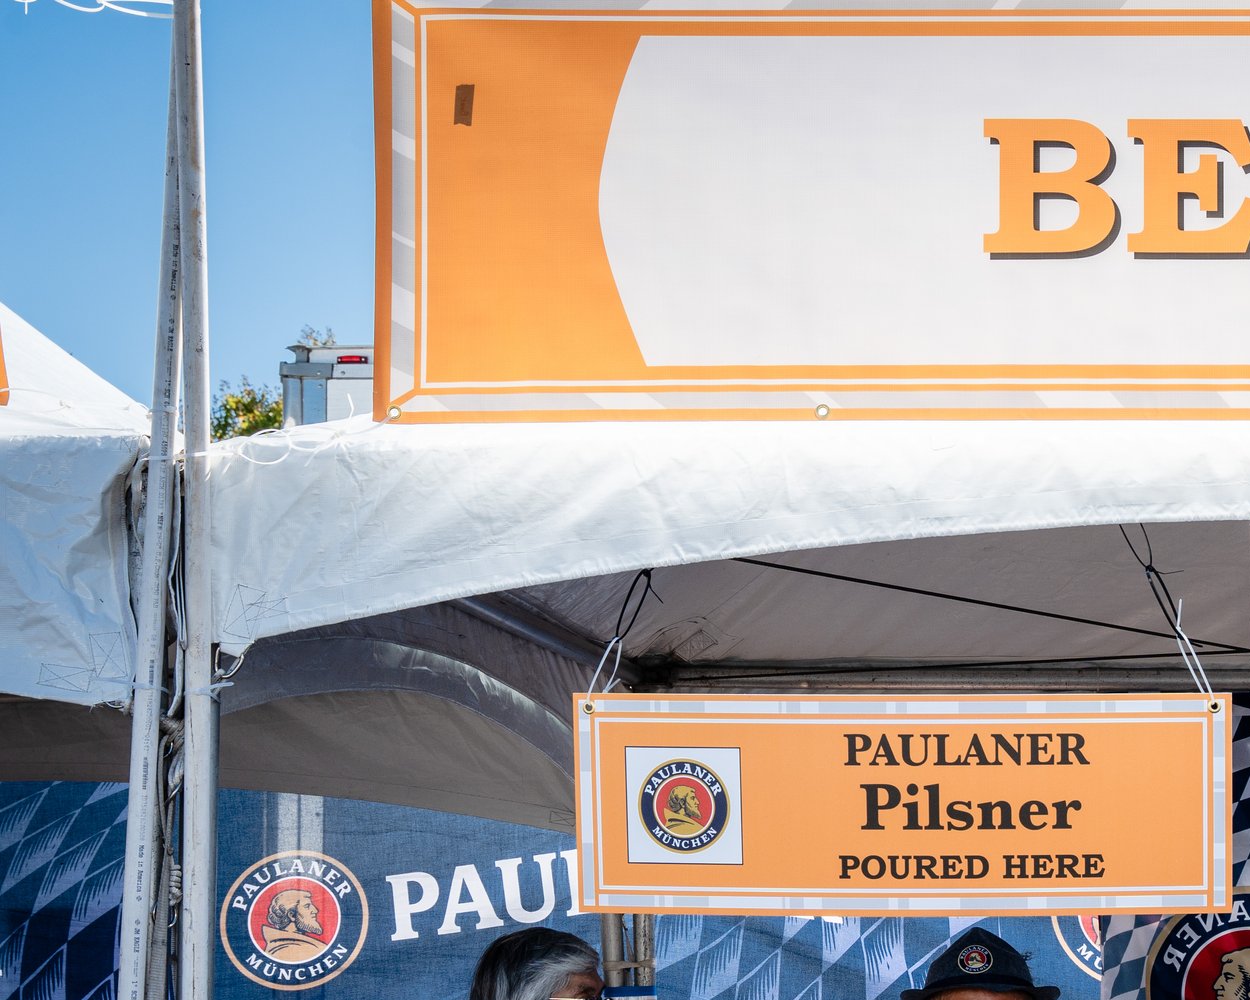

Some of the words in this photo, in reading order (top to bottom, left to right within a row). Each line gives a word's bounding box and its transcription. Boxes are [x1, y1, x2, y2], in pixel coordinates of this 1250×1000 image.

[844, 733, 1090, 766] PAULANER
[644, 763, 722, 796] PAULANER
[860, 783, 1082, 831] Pilsner
[652, 826, 717, 849] MÜNCHEN
[838, 855, 989, 880] POURED
[1003, 854, 1106, 879] HERE
[232, 859, 352, 911] PAULANER
[246, 943, 348, 981] MÜNCHEN
